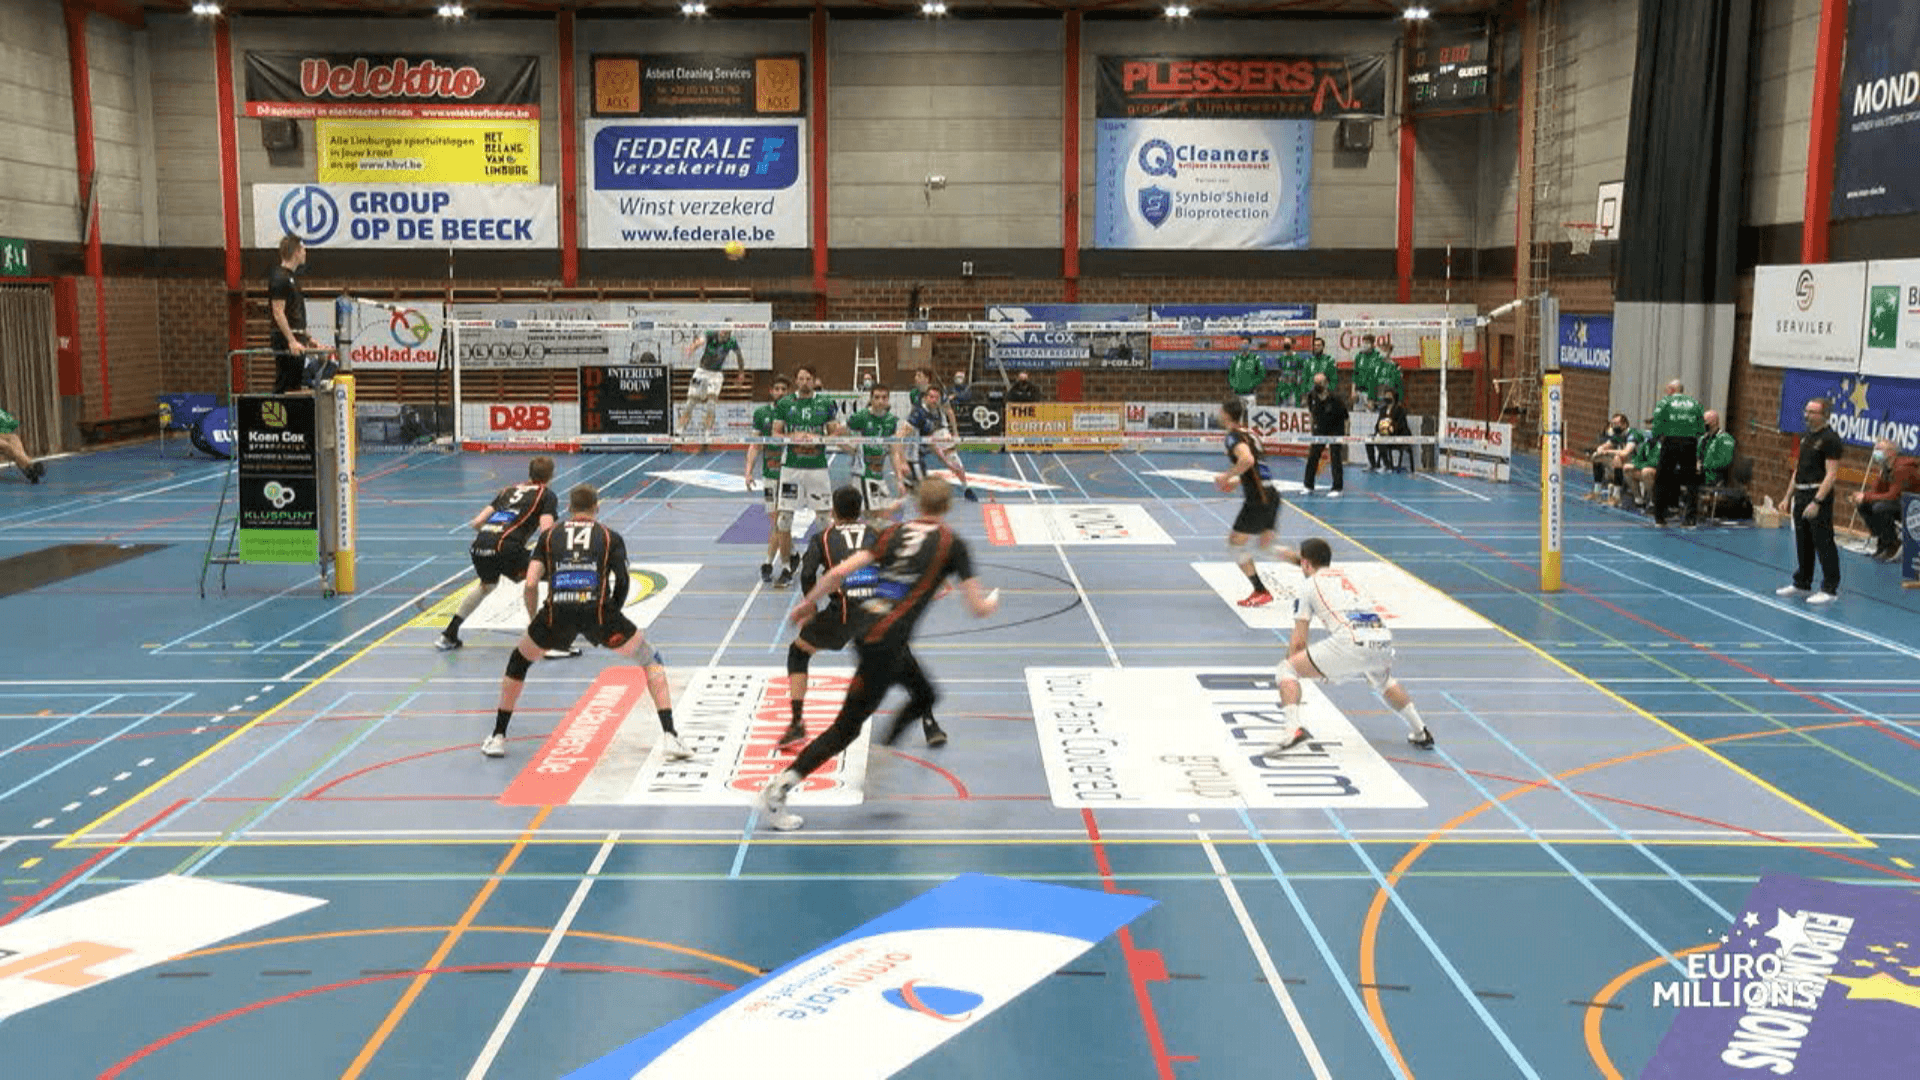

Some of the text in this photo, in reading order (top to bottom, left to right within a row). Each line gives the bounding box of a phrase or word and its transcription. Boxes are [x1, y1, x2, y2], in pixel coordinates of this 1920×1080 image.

[300, 58, 486, 98] Velektro
[646, 67, 751, 82] Asbest Cleaning Services
[1122, 61, 1315, 92] PLESSERS
[330, 136, 475, 149] Alle Limburgse sportuitslagen
[485, 132, 503, 142] HET
[485, 143, 524, 153] BELANG
[614, 137, 755, 159] FEDERALE
[485, 154, 504, 163] VAN
[485, 165, 529, 176] LIMBURG
[612, 161, 751, 178] Verzekering
[350, 191, 450, 214] GROUP
[1227, 190, 1269, 204] Shield
[619, 196, 775, 215] Winst verzekerd
[1175, 207, 1270, 220] Bioprotection
[351, 218, 533, 241] OP DE BEECK
[621, 226, 775, 241] www.federale.be
[1776, 319, 1834, 335] SERVILEX
[1560, 345, 1611, 367] EUROMILLIONS
[608, 368, 663, 378] INTERIEUR
[619, 379, 652, 392] BOUW
[489, 405, 552, 432] D&B
[1011, 406, 1036, 419] THE
[1010, 421, 1067, 433] CURTAIN
[249, 431, 305, 443] Koen Cox
[564, 526, 592, 551] 14
[841, 528, 866, 549] 17
